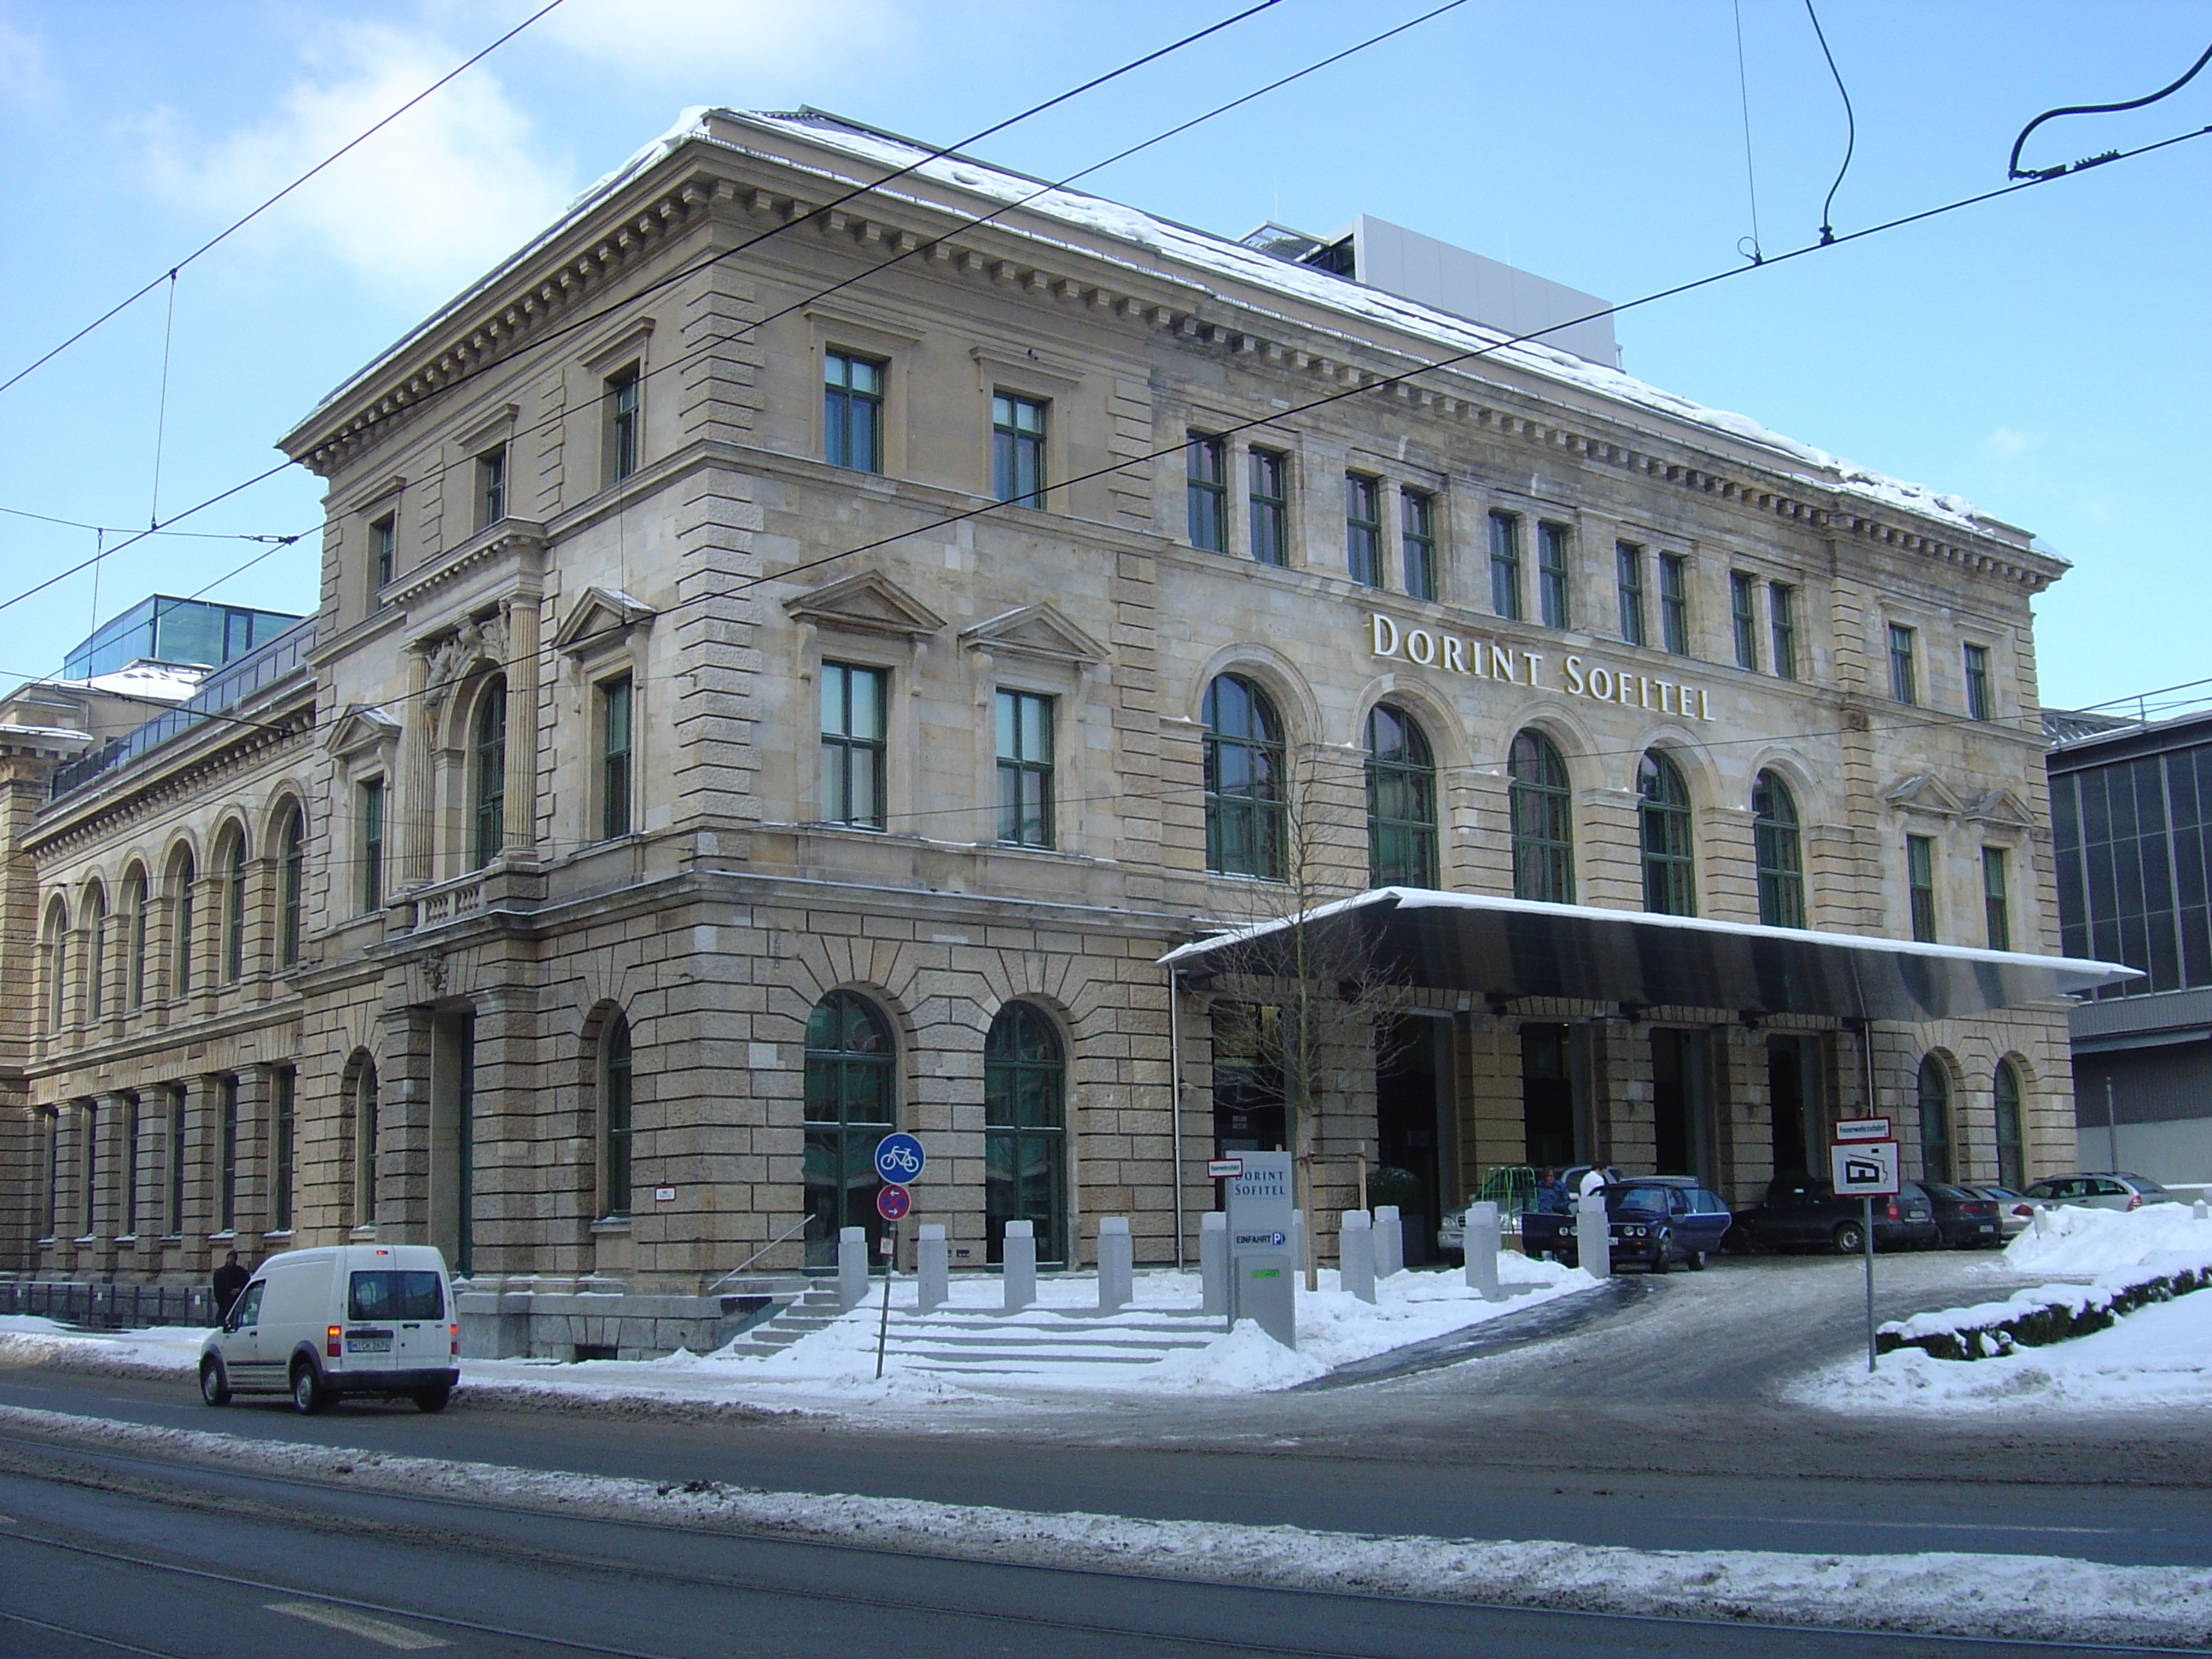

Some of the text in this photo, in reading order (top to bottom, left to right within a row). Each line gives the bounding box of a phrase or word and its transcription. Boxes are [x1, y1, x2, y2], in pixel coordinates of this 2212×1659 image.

[1369, 613, 1717, 722] DORINT SOFITEL
[1235, 1185, 1285, 1196] SOFITEL
[1236, 1233, 1281, 1244] EINFAHRT P
